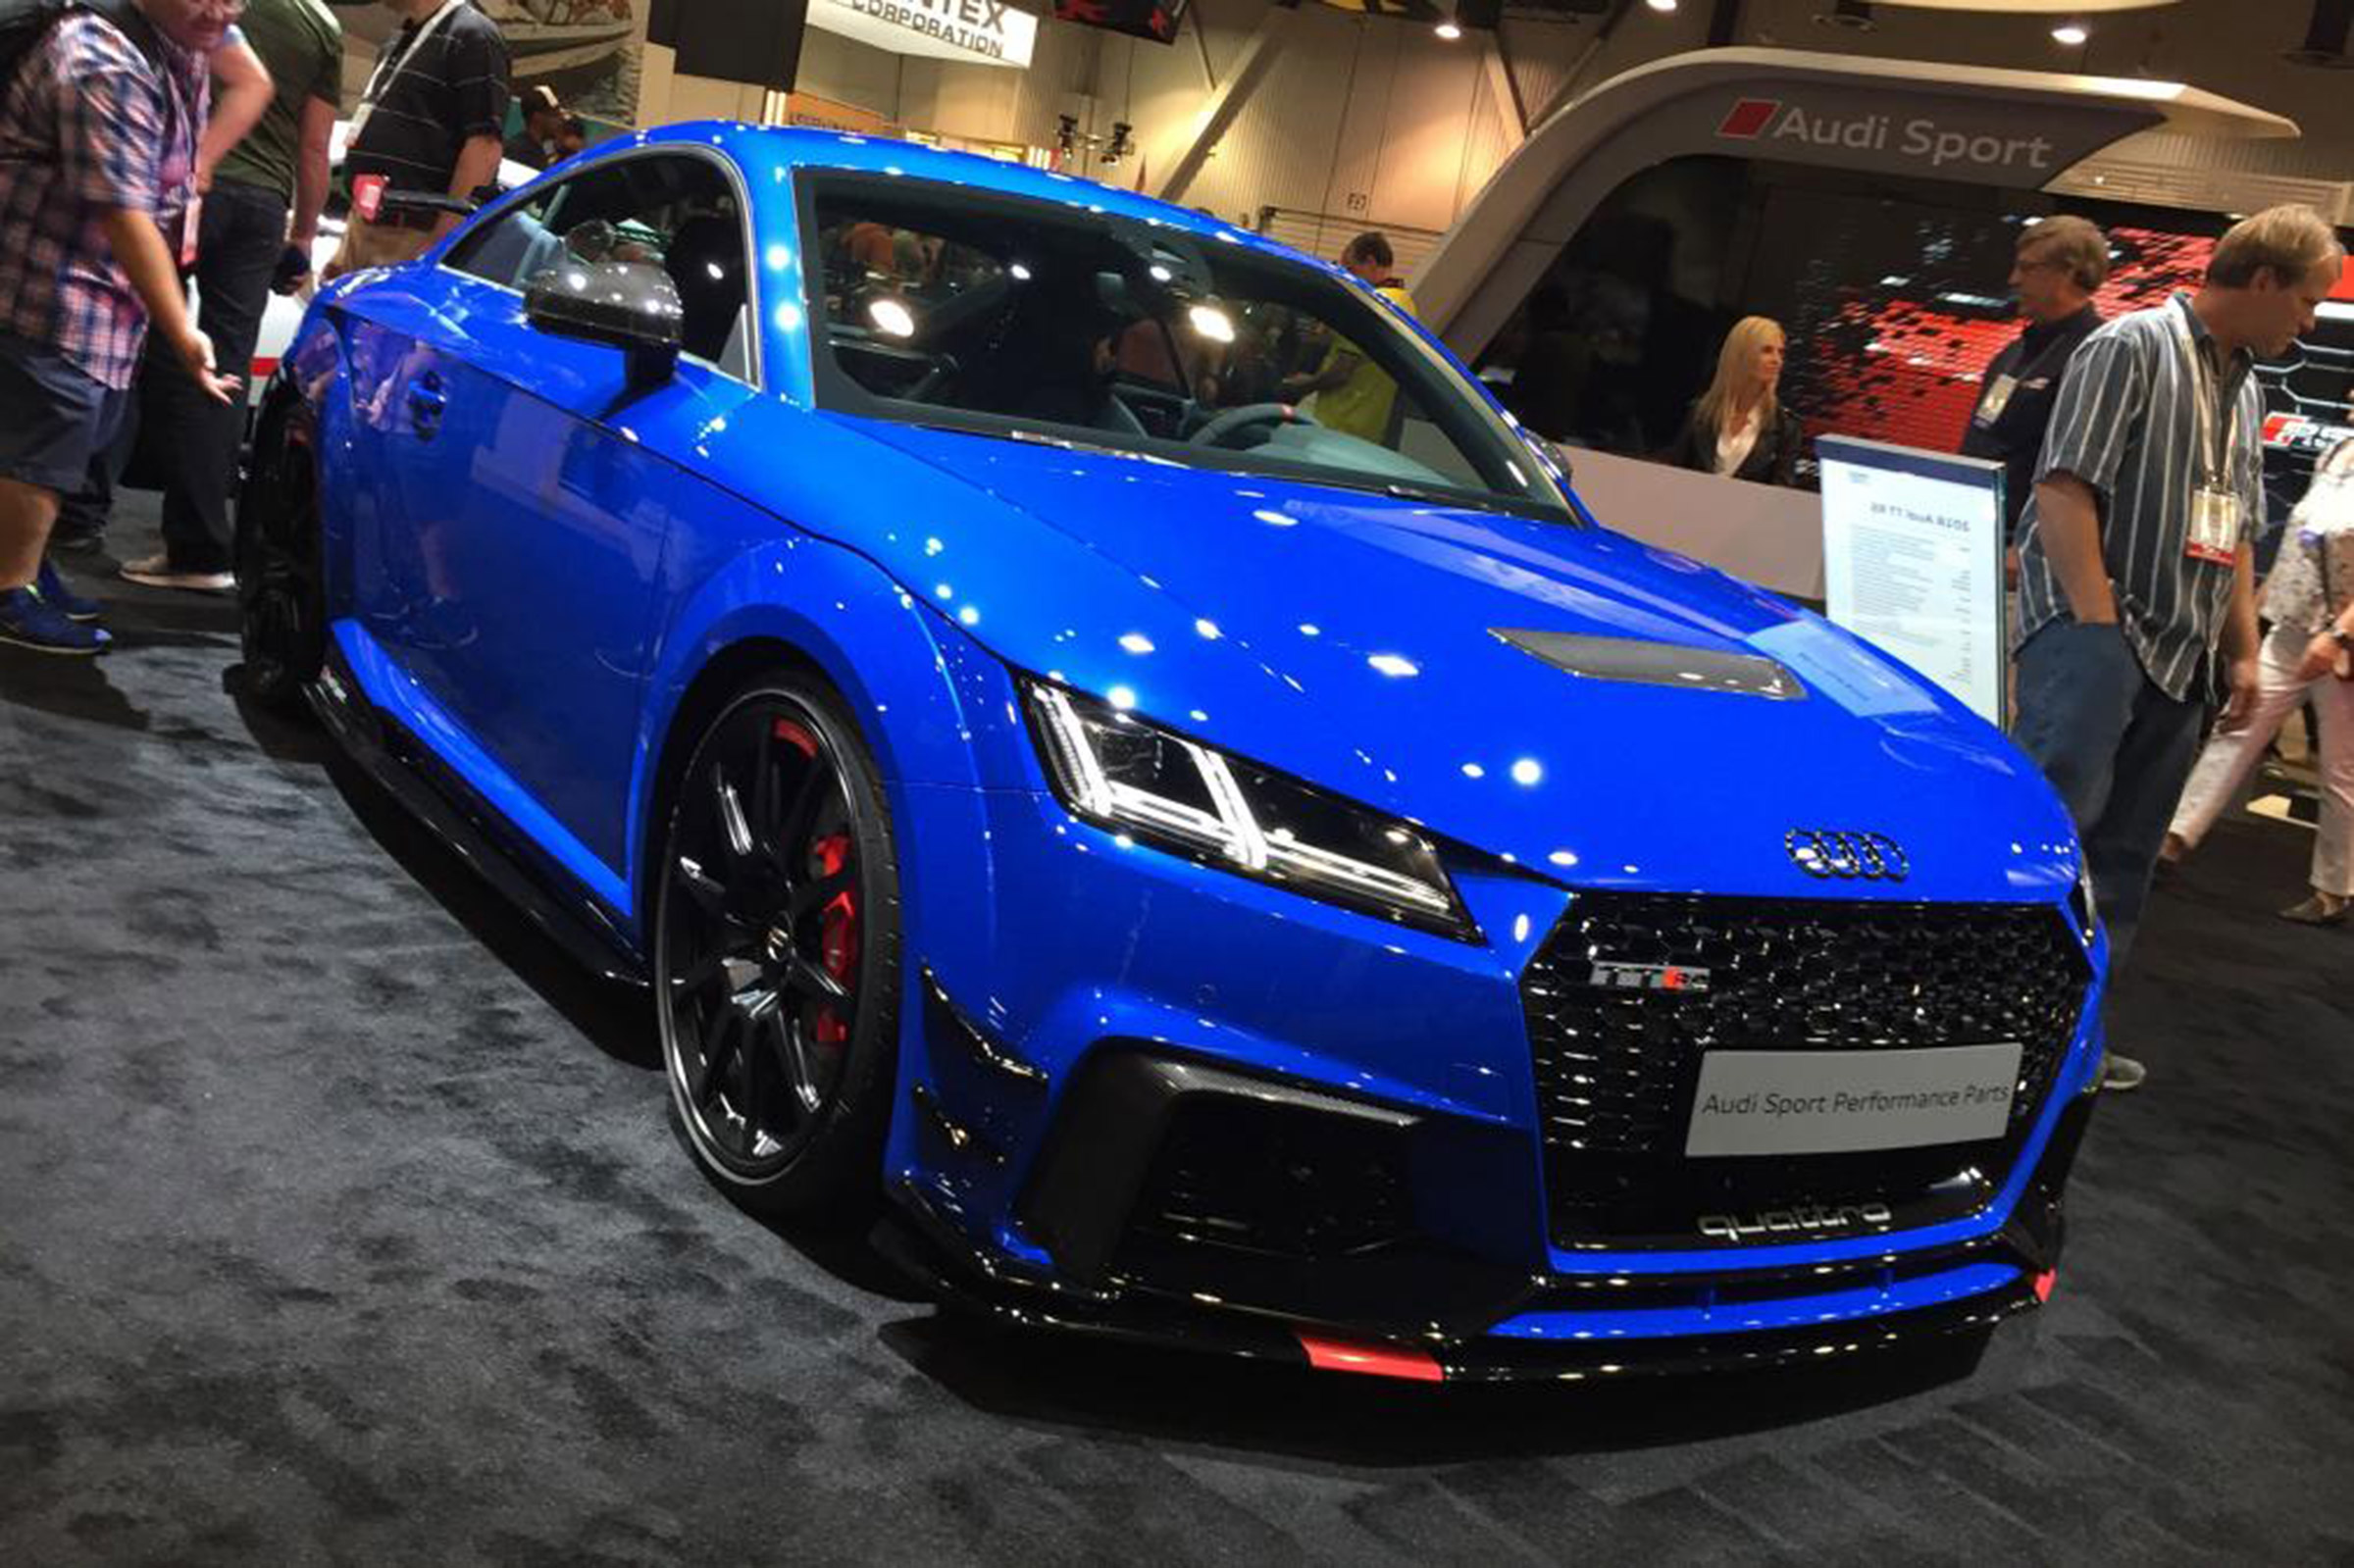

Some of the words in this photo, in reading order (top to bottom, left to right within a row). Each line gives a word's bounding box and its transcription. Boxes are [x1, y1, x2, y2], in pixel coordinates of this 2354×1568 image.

[851, 0, 1003, 59] CORPORATION
[1773, 107, 1889, 150] Audi
[1899, 119, 2053, 168] Sport
[1702, 1092, 1759, 1115] Audi
[1765, 1092, 1826, 1118] Sport
[1832, 1087, 1961, 1114] Performance
[1964, 1083, 2010, 1107] Parts
[1696, 1202, 1892, 1241] quattro
